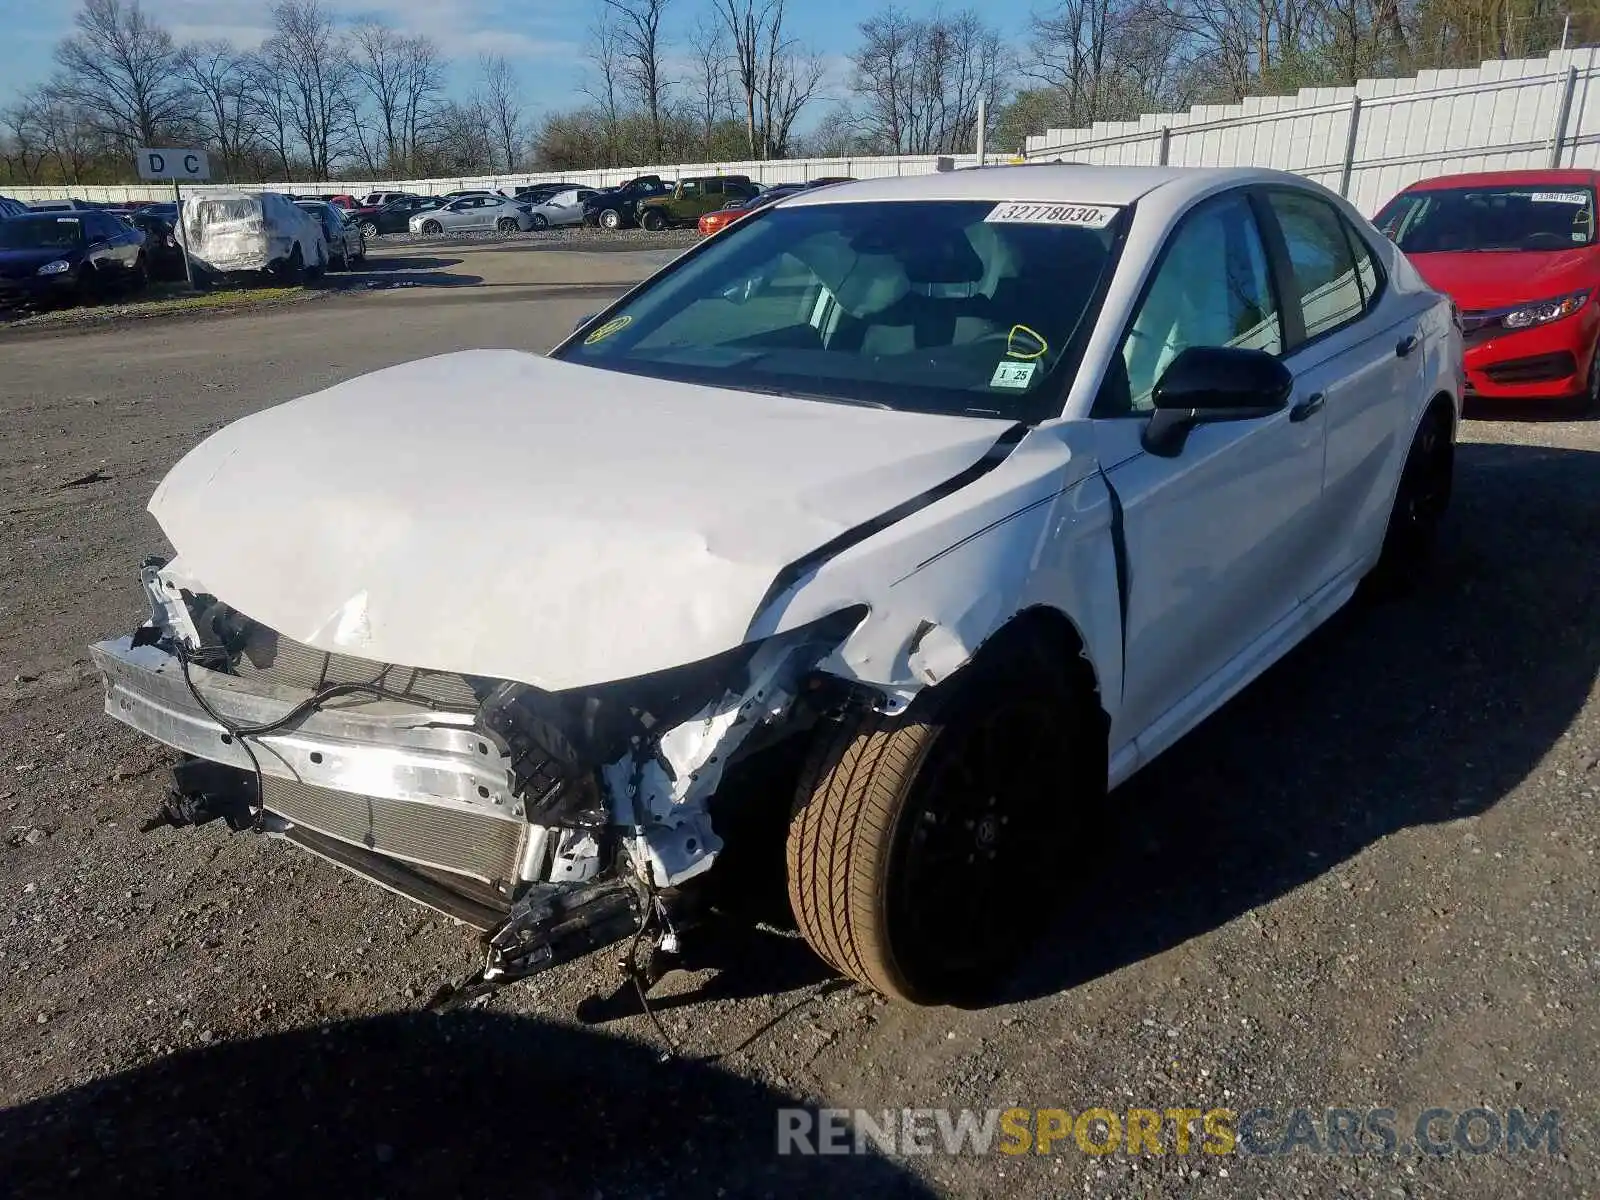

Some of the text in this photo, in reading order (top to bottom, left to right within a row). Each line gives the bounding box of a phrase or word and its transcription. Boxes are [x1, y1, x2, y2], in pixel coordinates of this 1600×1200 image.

[149, 154, 199, 173] D C
[1013, 370, 1028, 380] 25
